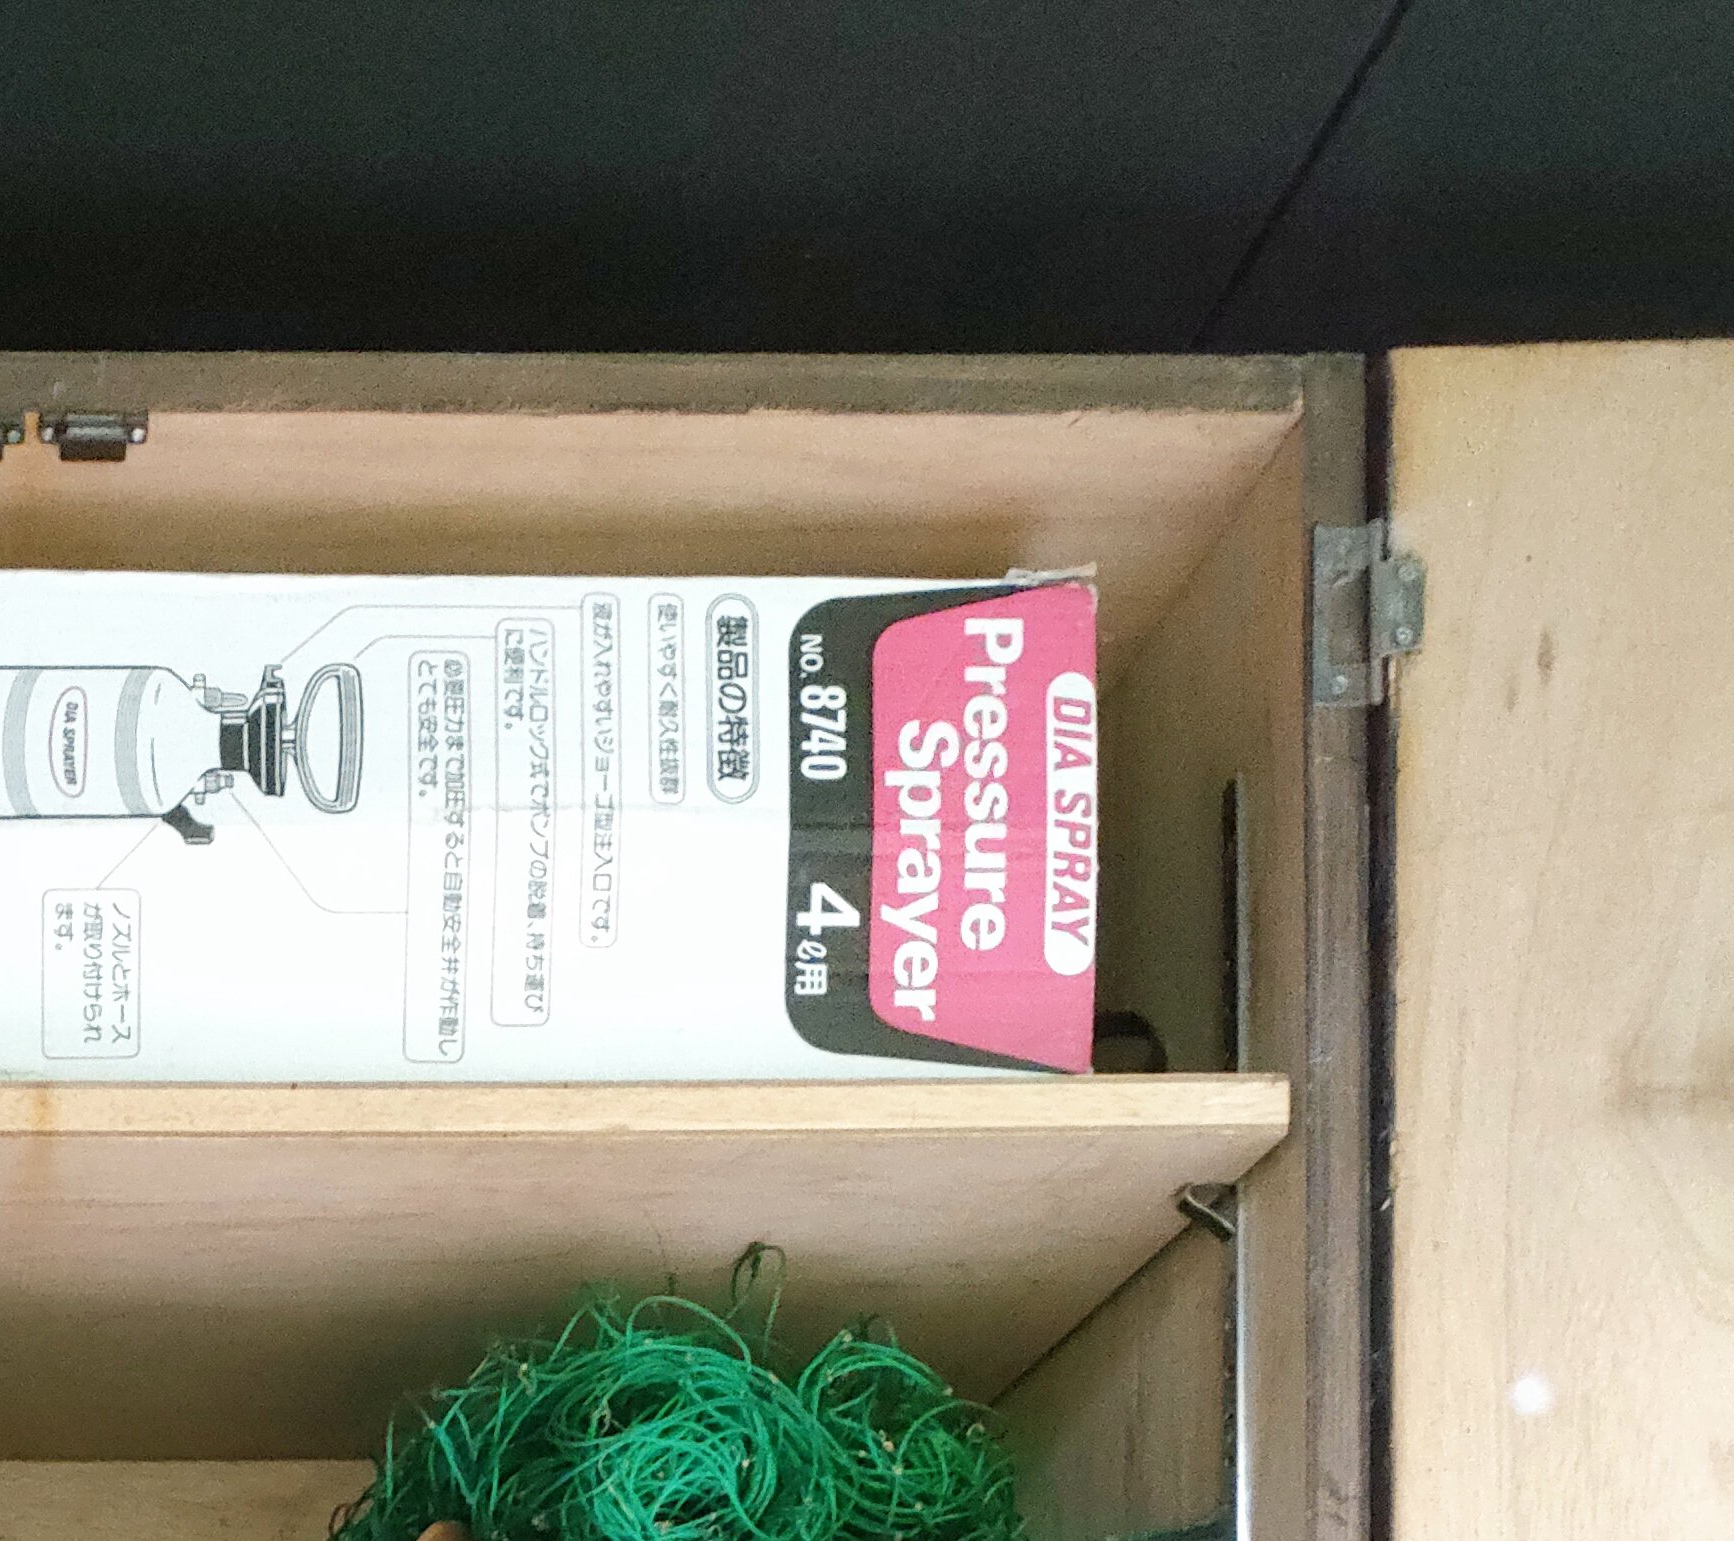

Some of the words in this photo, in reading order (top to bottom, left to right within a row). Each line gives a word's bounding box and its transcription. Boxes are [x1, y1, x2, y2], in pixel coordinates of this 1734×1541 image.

[717, 615, 750, 781] 製品の特徴
[798, 633, 823, 679] NO.
[798, 684, 847, 781] 8740
[961, 617, 1025, 951] Pressure
[1050, 696, 1093, 770] DIA
[55, 902, 75, 952] ます。
[880, 719, 961, 1021] Sprayer
[1050, 788, 1095, 947] SPRAY
[83, 901, 103, 1044] が取り付けられ
[112, 901, 132, 1043] ノズルとホース
